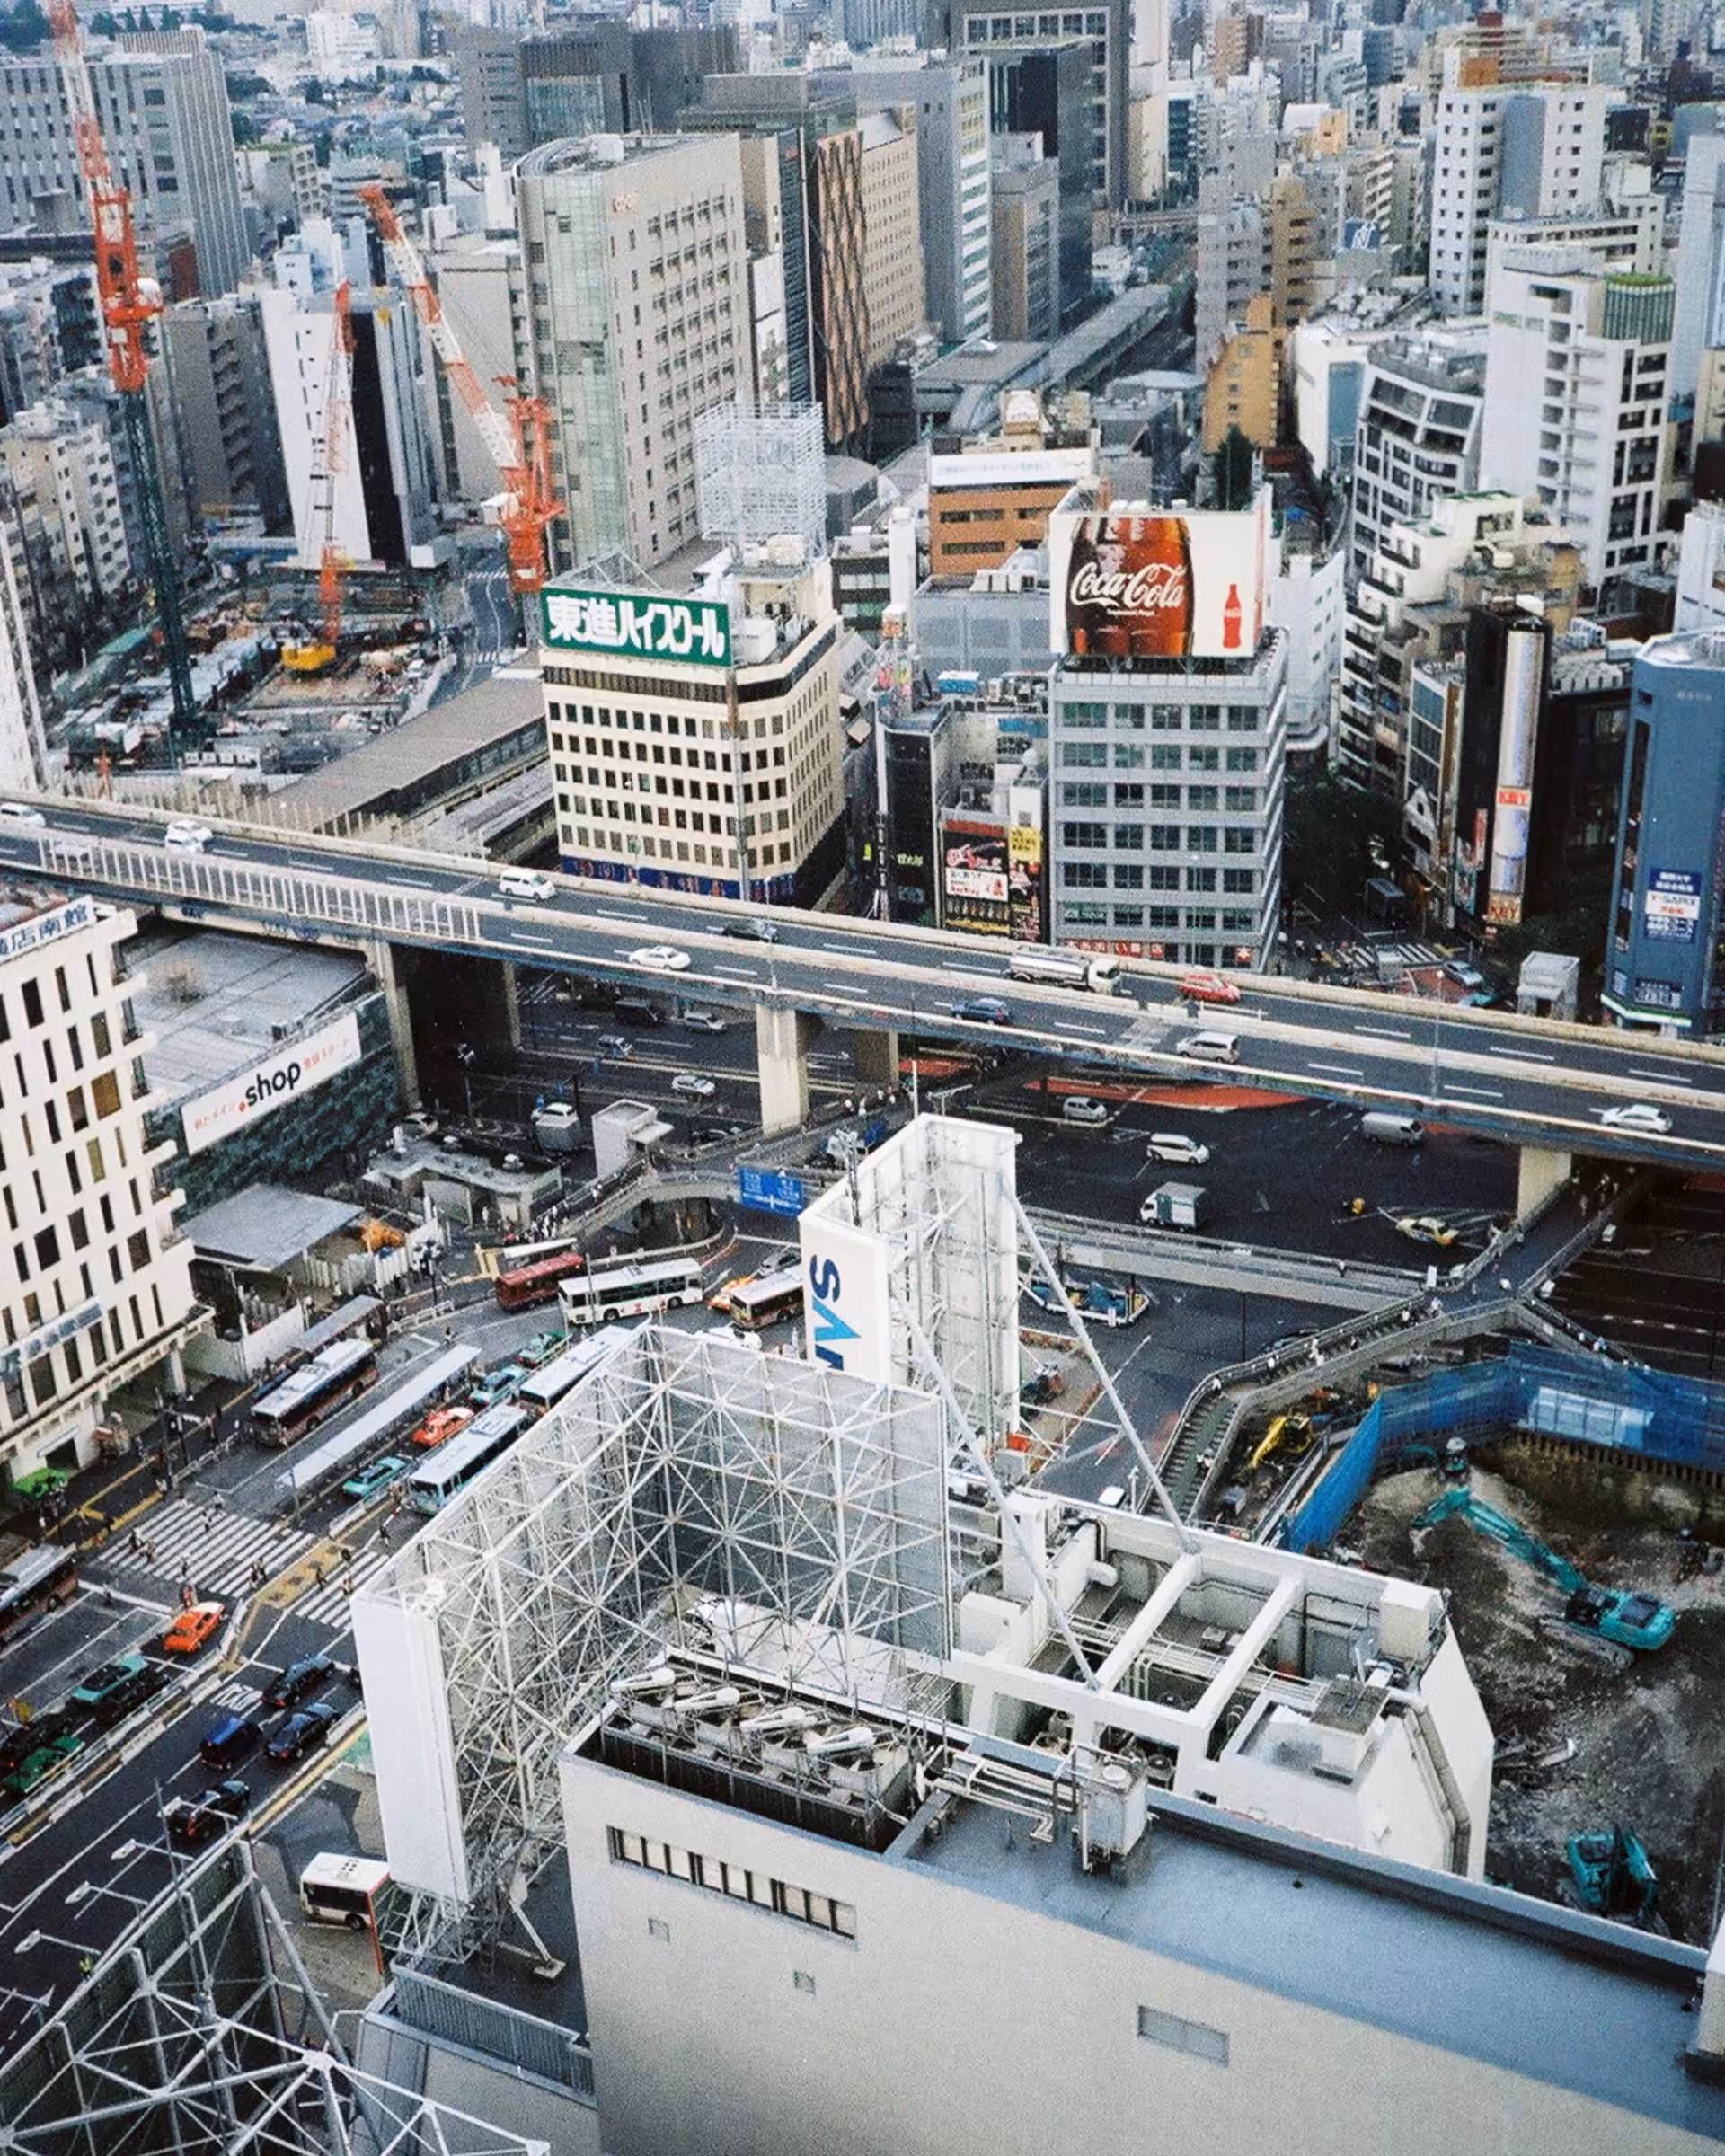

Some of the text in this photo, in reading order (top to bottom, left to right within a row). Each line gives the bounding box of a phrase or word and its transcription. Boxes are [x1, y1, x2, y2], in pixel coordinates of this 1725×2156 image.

[546, 594, 725, 658] 東進ハイスクール
